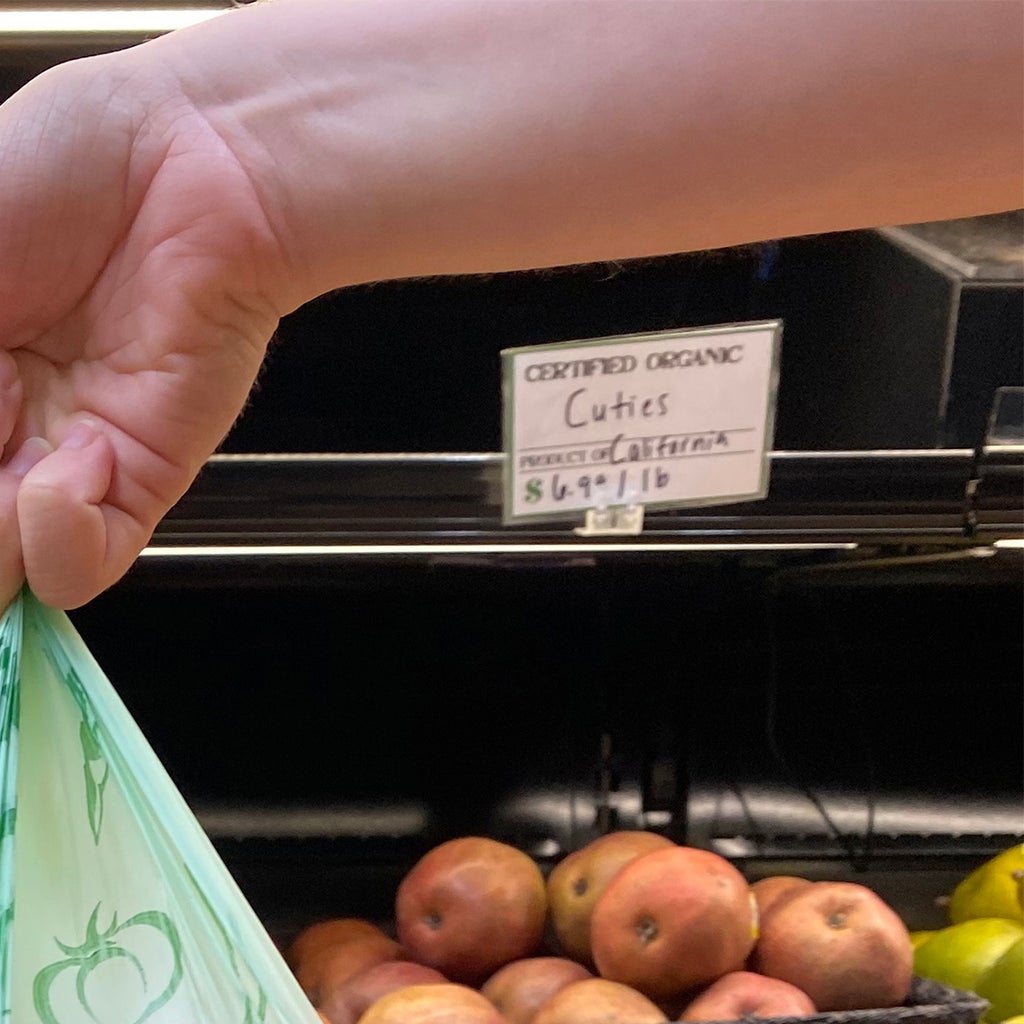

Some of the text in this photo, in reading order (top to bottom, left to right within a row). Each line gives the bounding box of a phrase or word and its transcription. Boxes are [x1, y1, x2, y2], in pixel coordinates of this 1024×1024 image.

[524, 345, 744, 382] CERTIFIED ORGANIC
[564, 388, 669, 428] Cuties
[520, 450, 586, 466] PRODUCT
[609, 430, 728, 465] California
